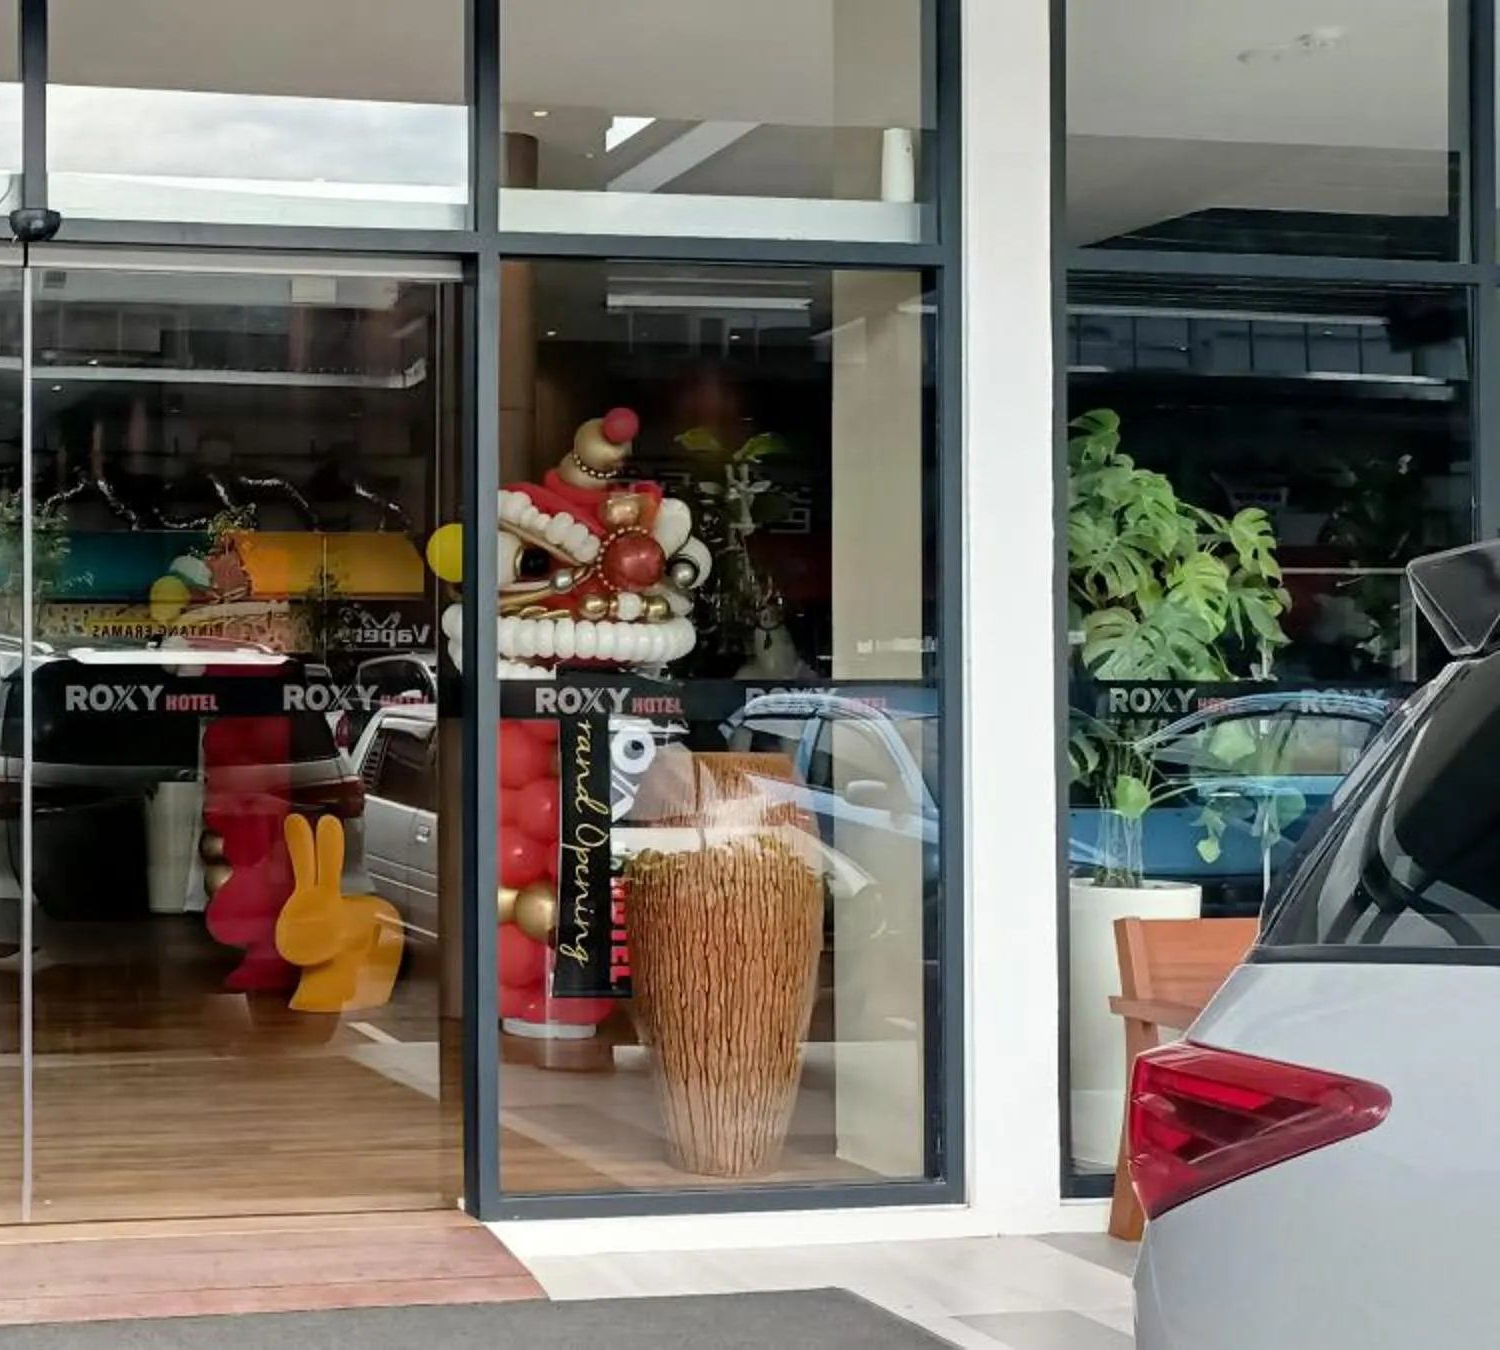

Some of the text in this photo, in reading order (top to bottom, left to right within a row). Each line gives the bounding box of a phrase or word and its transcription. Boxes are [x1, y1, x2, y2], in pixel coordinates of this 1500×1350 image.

[65, 684, 219, 712] ROXY HOTEL
[283, 683, 379, 712] ROXY
[535, 686, 684, 714] ROXY HOTEL
[1109, 687, 1197, 714] ROXY
[560, 719, 609, 969] rand Opening
